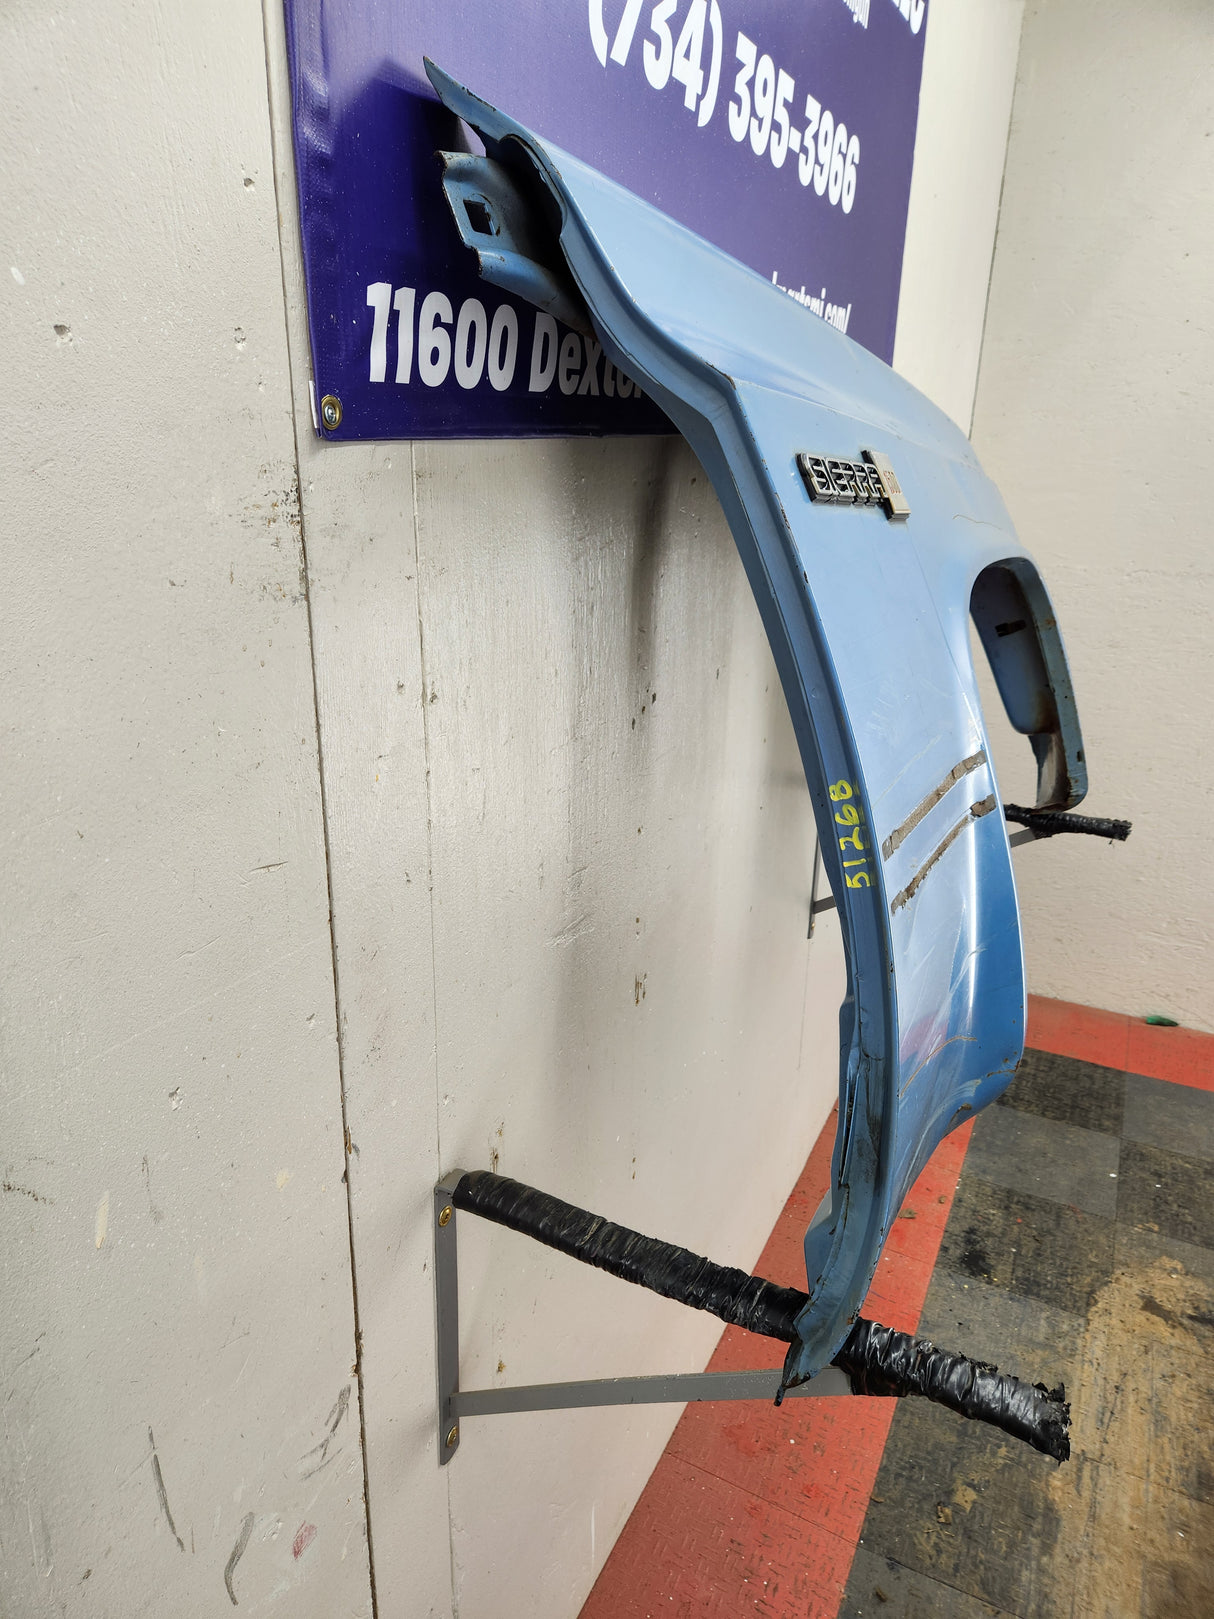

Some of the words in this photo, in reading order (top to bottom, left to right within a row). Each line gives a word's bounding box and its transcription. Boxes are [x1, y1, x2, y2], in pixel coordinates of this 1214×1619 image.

[729, 30, 860, 215] 395-3966
[366, 281, 519, 392] 11600
[797, 453, 889, 506] SIERRA
[829, 779, 871, 888] 51268
